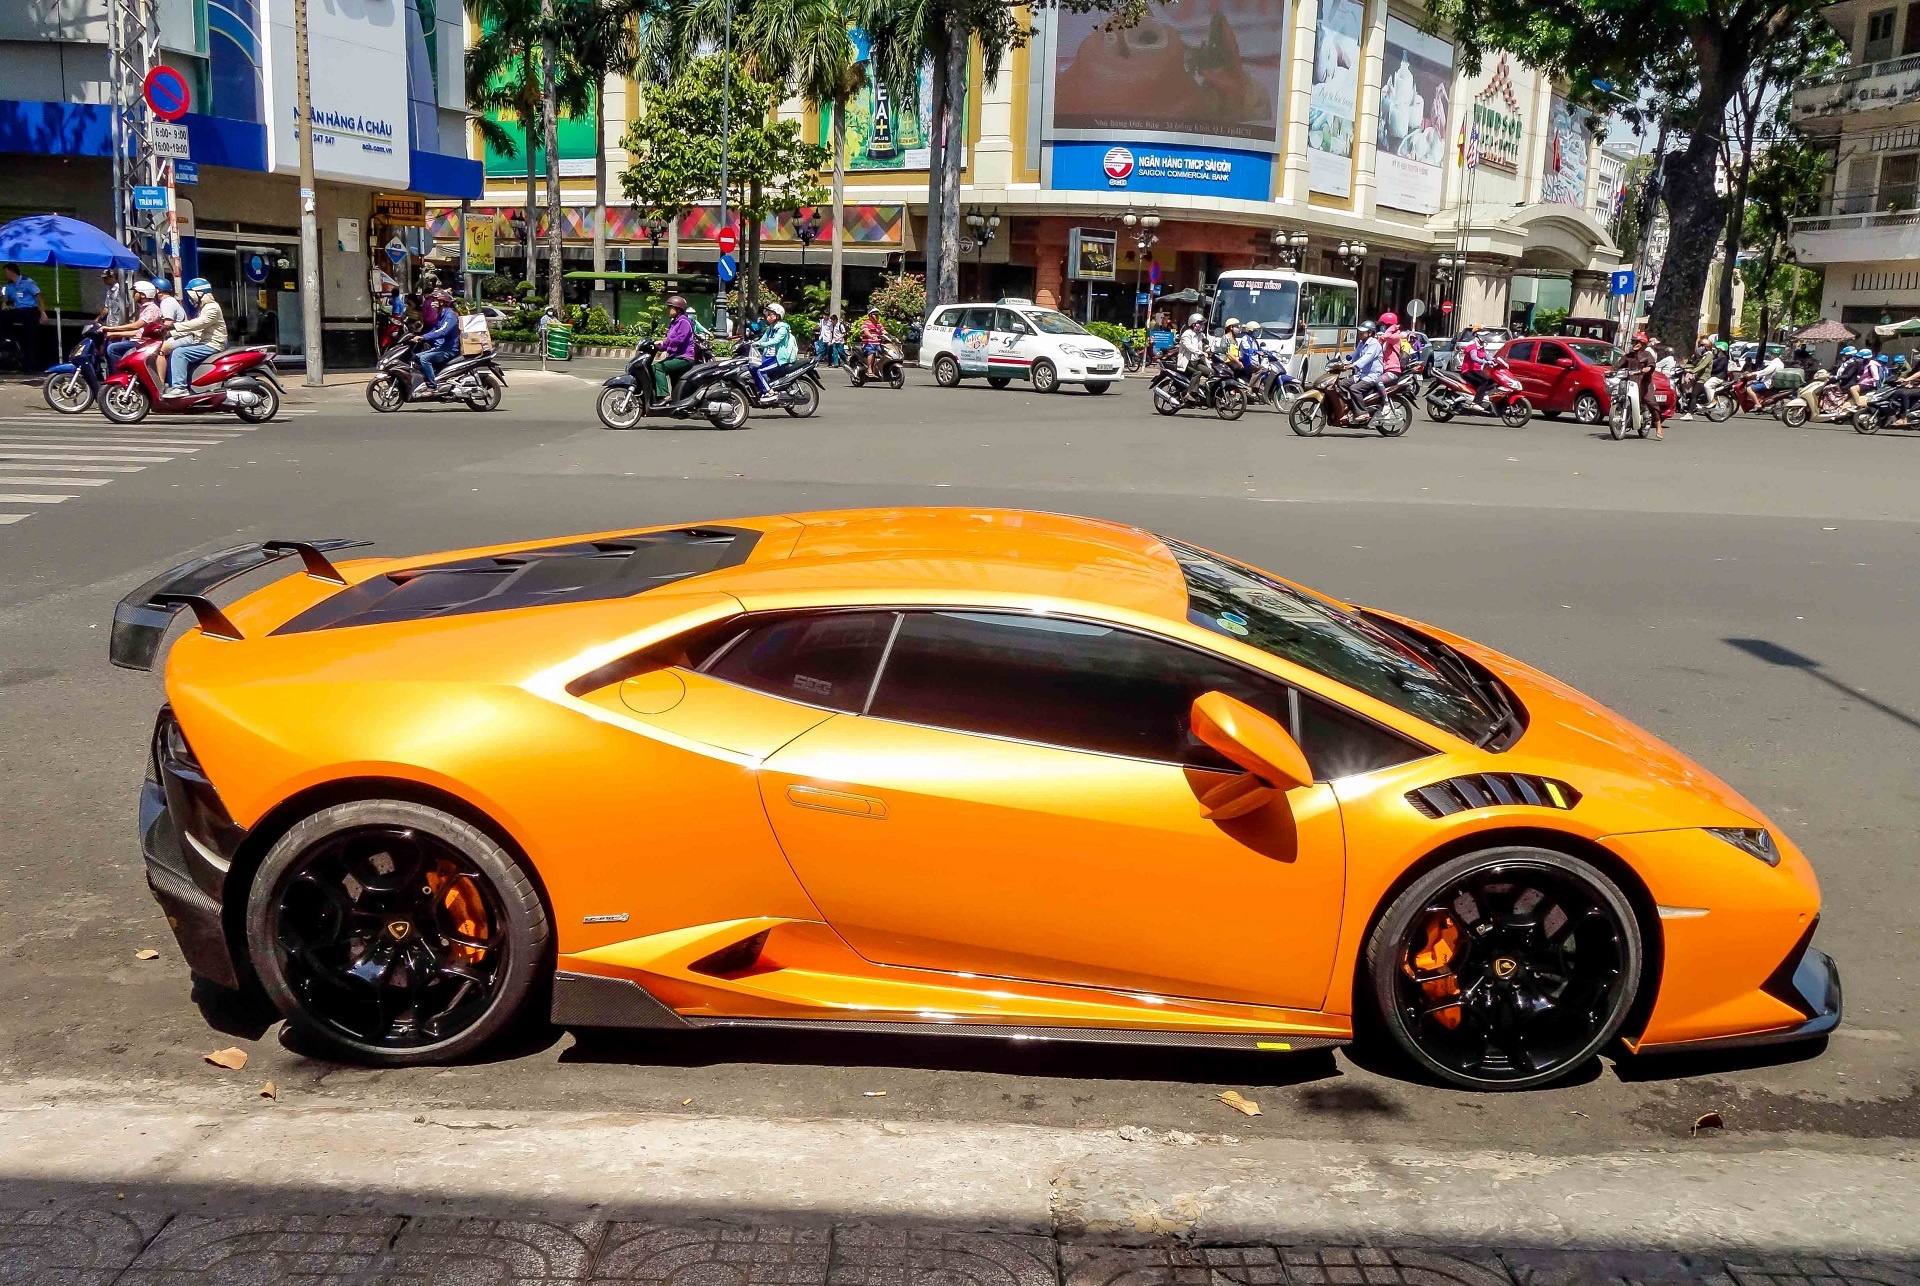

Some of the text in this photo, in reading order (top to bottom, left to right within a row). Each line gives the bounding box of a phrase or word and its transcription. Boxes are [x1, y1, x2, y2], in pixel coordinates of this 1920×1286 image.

[294, 106, 392, 135] NÂN HÀNG Á CHÂU
[1474, 103, 1522, 139] WINDSOR
[313, 133, 334, 146] 247 247
[362, 143, 393, 155] acb.com.vn
[1138, 155, 1161, 168] NGÂN
[1162, 156, 1182, 169] HÀNG
[1184, 159, 1204, 171] TMCP
[1204, 160, 1216, 172] SÀI
[1138, 169, 1230, 182] SAIGON COMMERCIAL BANK
[1619, 275, 1628, 289] P
